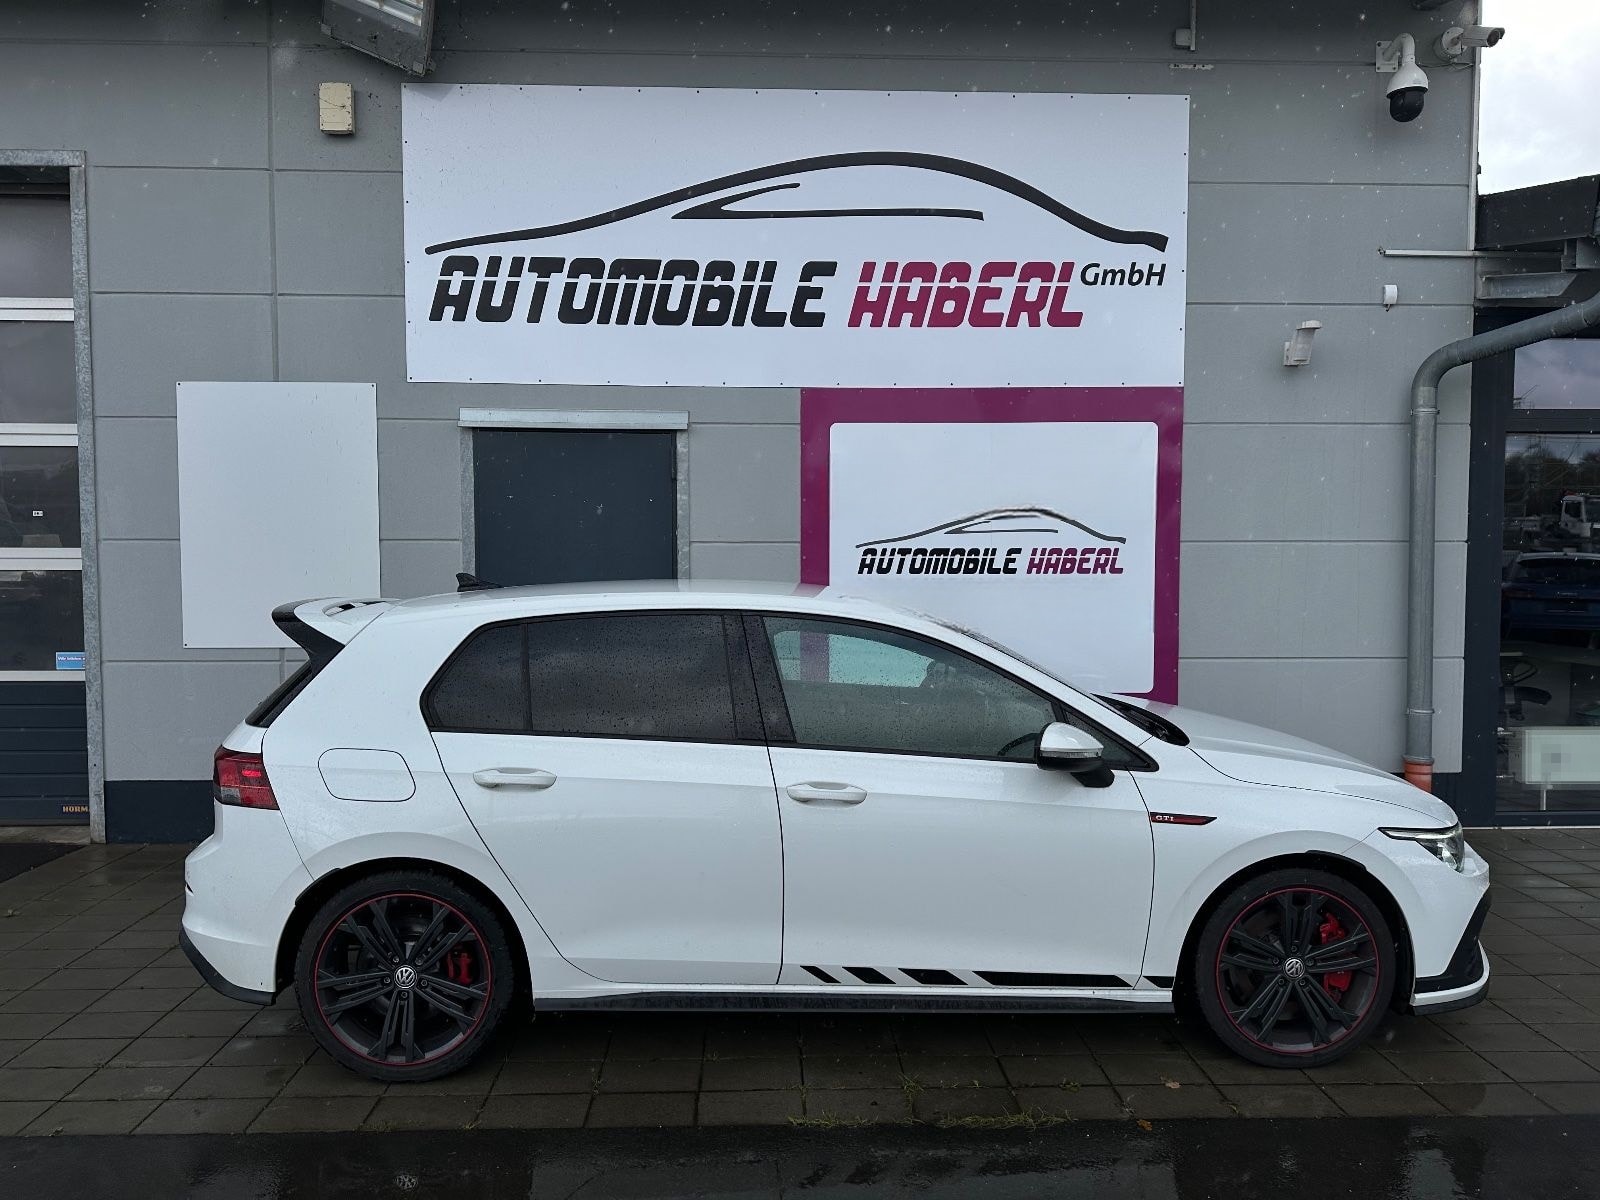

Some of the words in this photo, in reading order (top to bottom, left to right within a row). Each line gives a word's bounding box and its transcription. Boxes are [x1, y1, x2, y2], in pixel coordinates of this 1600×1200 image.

[428, 255, 838, 327] AUTOMOBILE
[847, 261, 1084, 327] HABERL
[1080, 262, 1167, 286] GmbH
[857, 547, 1022, 575] AUTOMOBILE
[1026, 547, 1124, 575] HABERL
